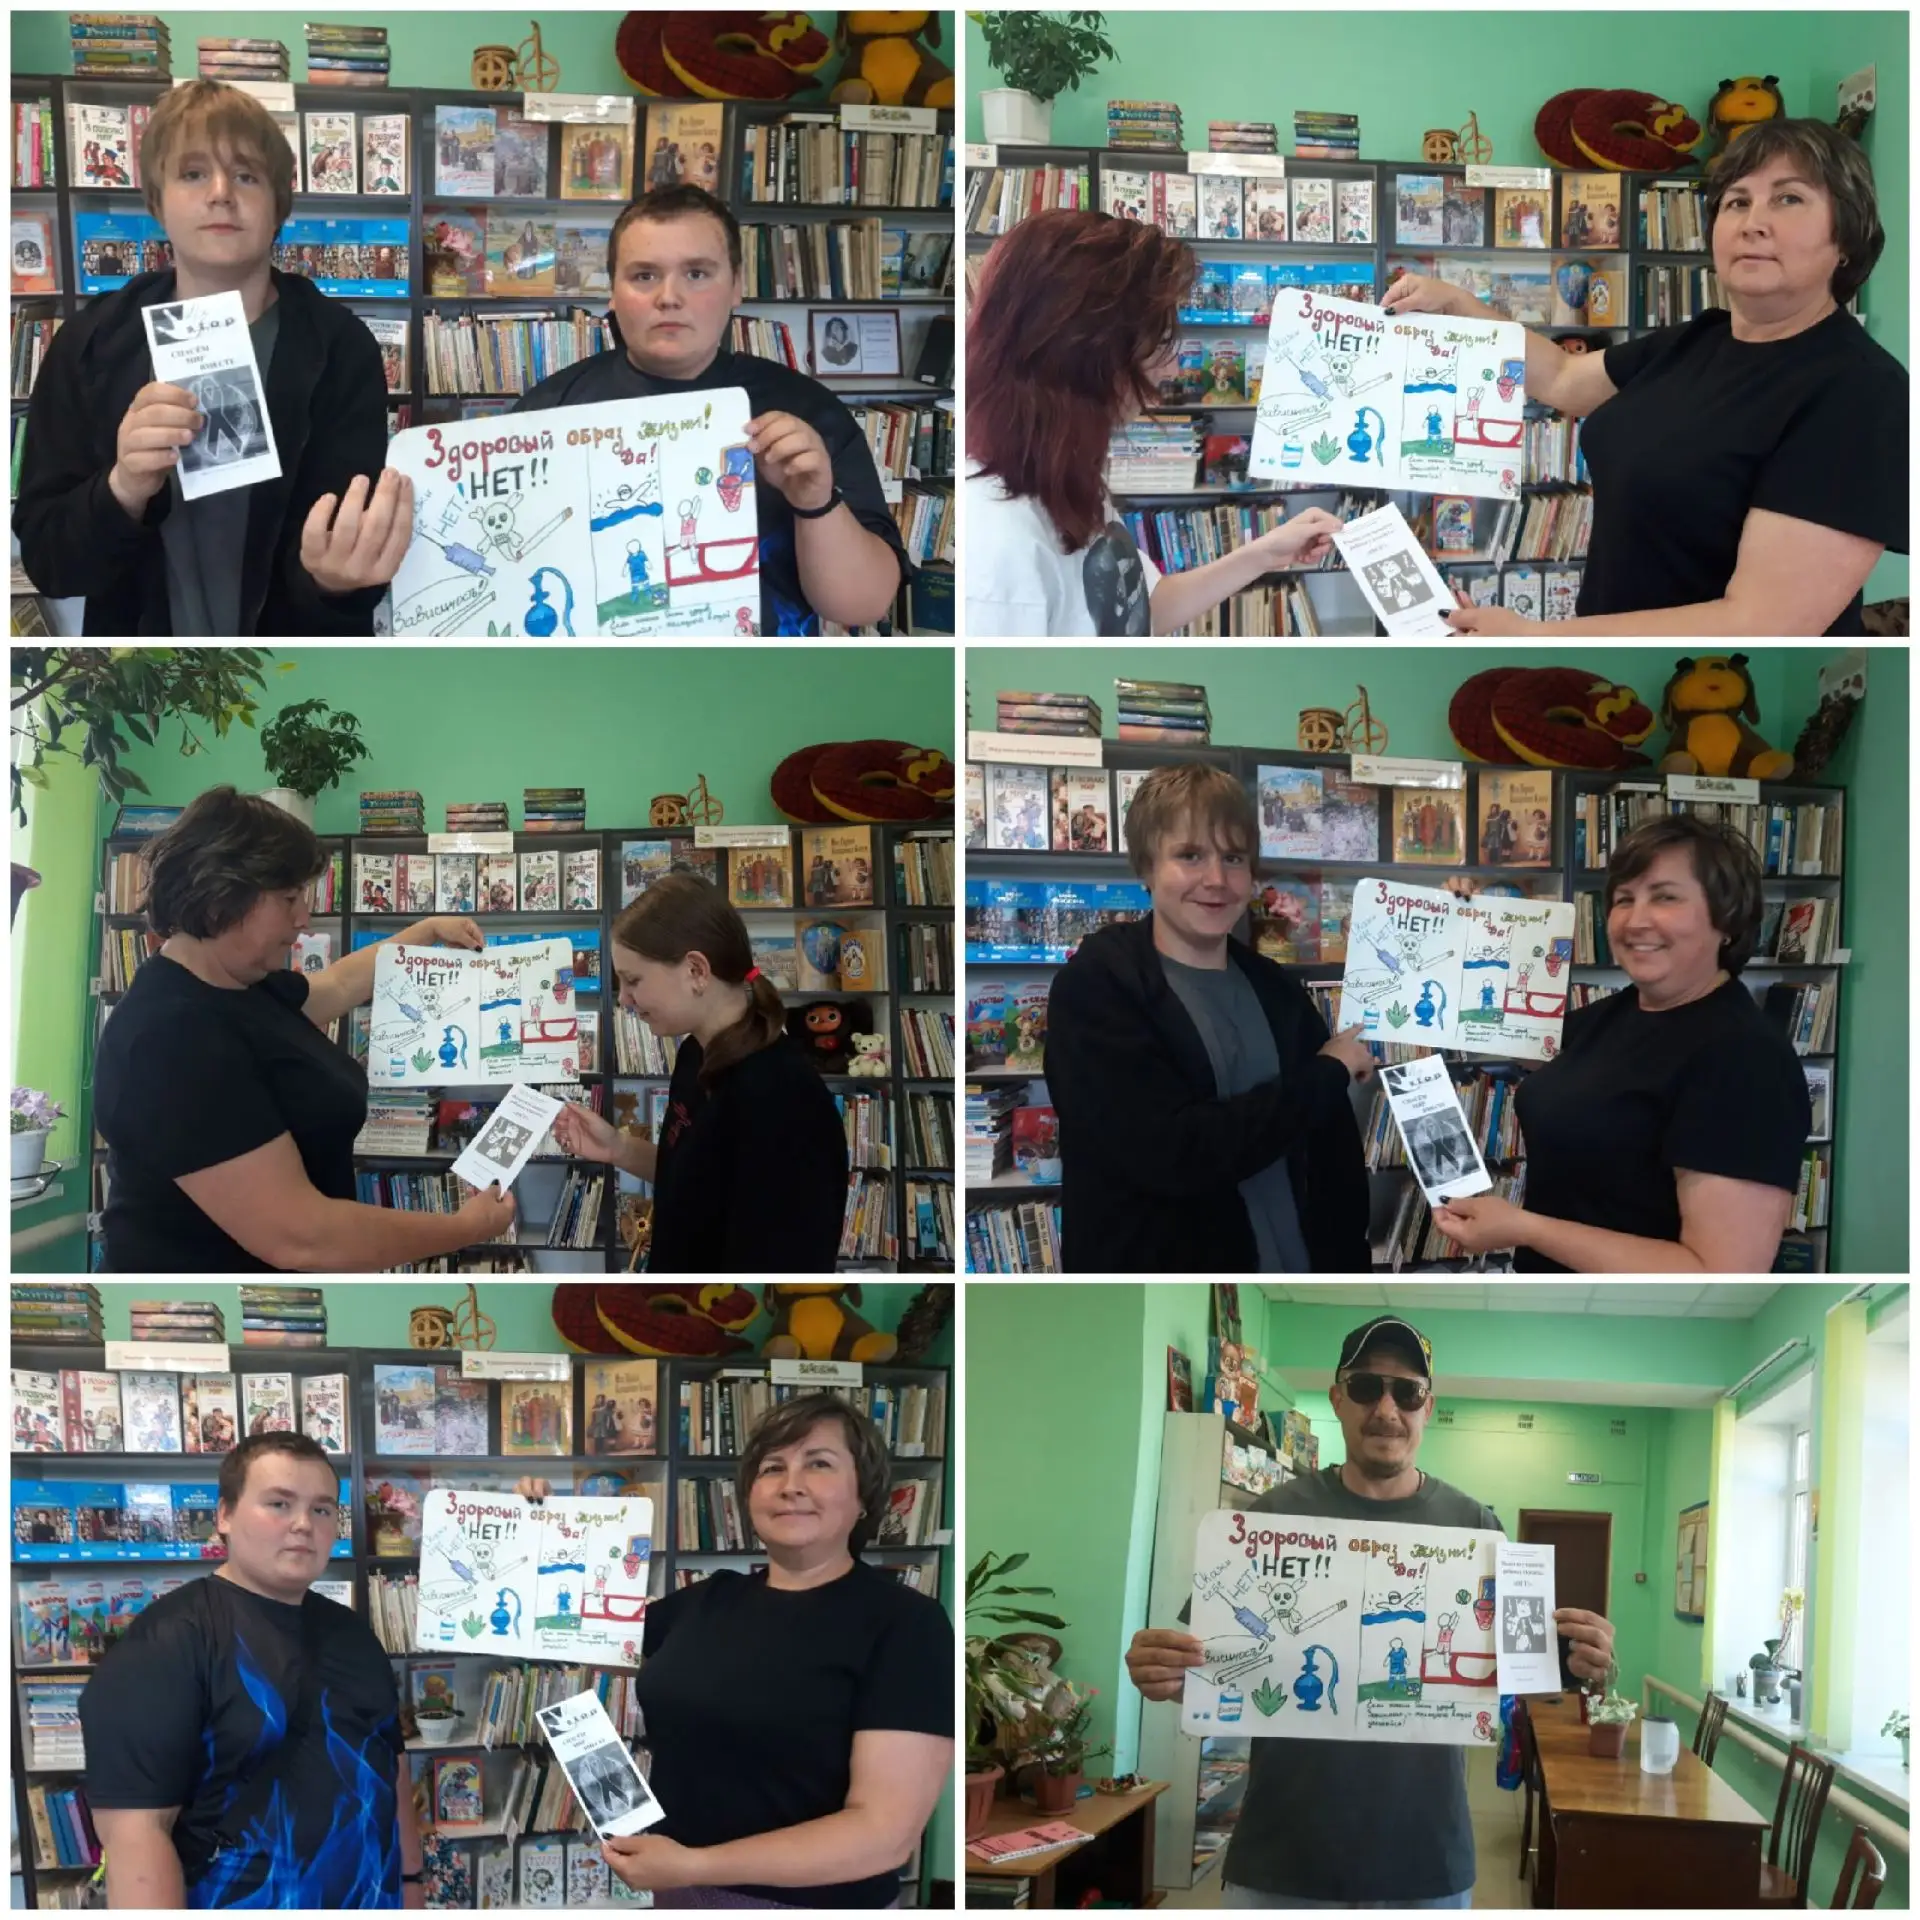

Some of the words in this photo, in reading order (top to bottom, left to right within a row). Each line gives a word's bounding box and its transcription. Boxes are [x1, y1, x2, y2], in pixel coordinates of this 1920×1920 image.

[1299, 292, 1385, 335] Здоровый
[1325, 329, 1380, 354] НЕТ!!
[425, 428, 554, 481] Здоровый
[470, 457, 548, 500] НЕТ!!
[1375, 882, 1449, 917] Здоровый
[1398, 913, 1444, 934] НЕТ!!
[395, 946, 462, 974] Здоровый
[416, 970, 460, 986] НЕТ!!
[445, 1491, 521, 1525] Здоровый
[469, 1521, 517, 1540] НЕТ!!
[1229, 1513, 1337, 1559] Здоровый
[1262, 1553, 1331, 1578] НЕТ!!
